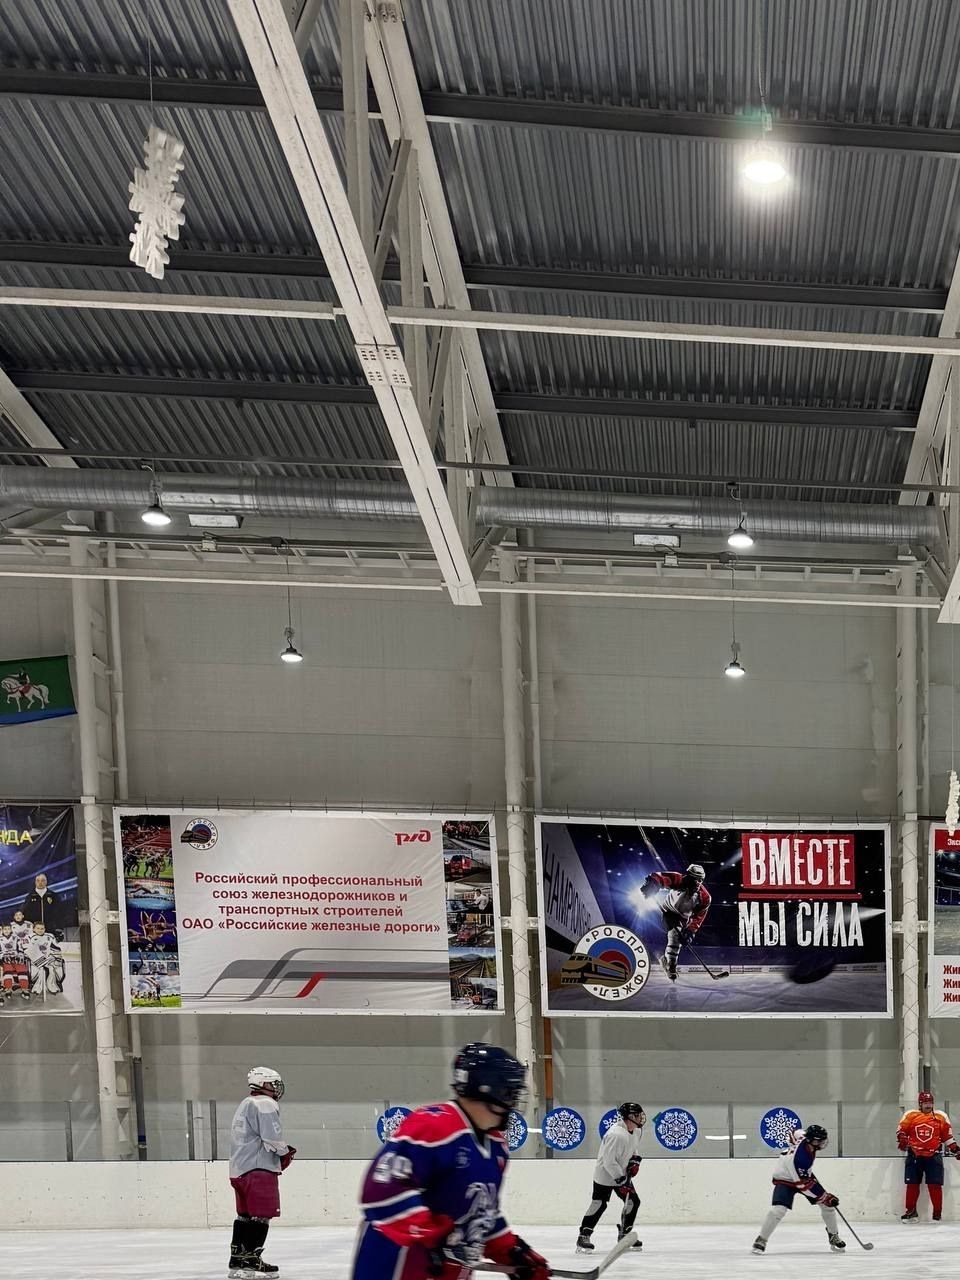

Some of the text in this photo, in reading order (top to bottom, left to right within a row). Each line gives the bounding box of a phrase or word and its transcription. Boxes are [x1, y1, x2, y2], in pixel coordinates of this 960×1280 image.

[748, 837, 851, 886] ВМЕСТЕ
[195, 871, 423, 887] Российский профессиональный
[212, 889, 408, 902] союз железнодорожников и
[218, 905, 403, 918] транспортных строителей
[182, 918, 441, 934] ОАО «Российские железные дороги»
[738, 901, 864, 947] МЫ СИЛА
[591, 926, 647, 998] РОСПРОФЖЕЛ
